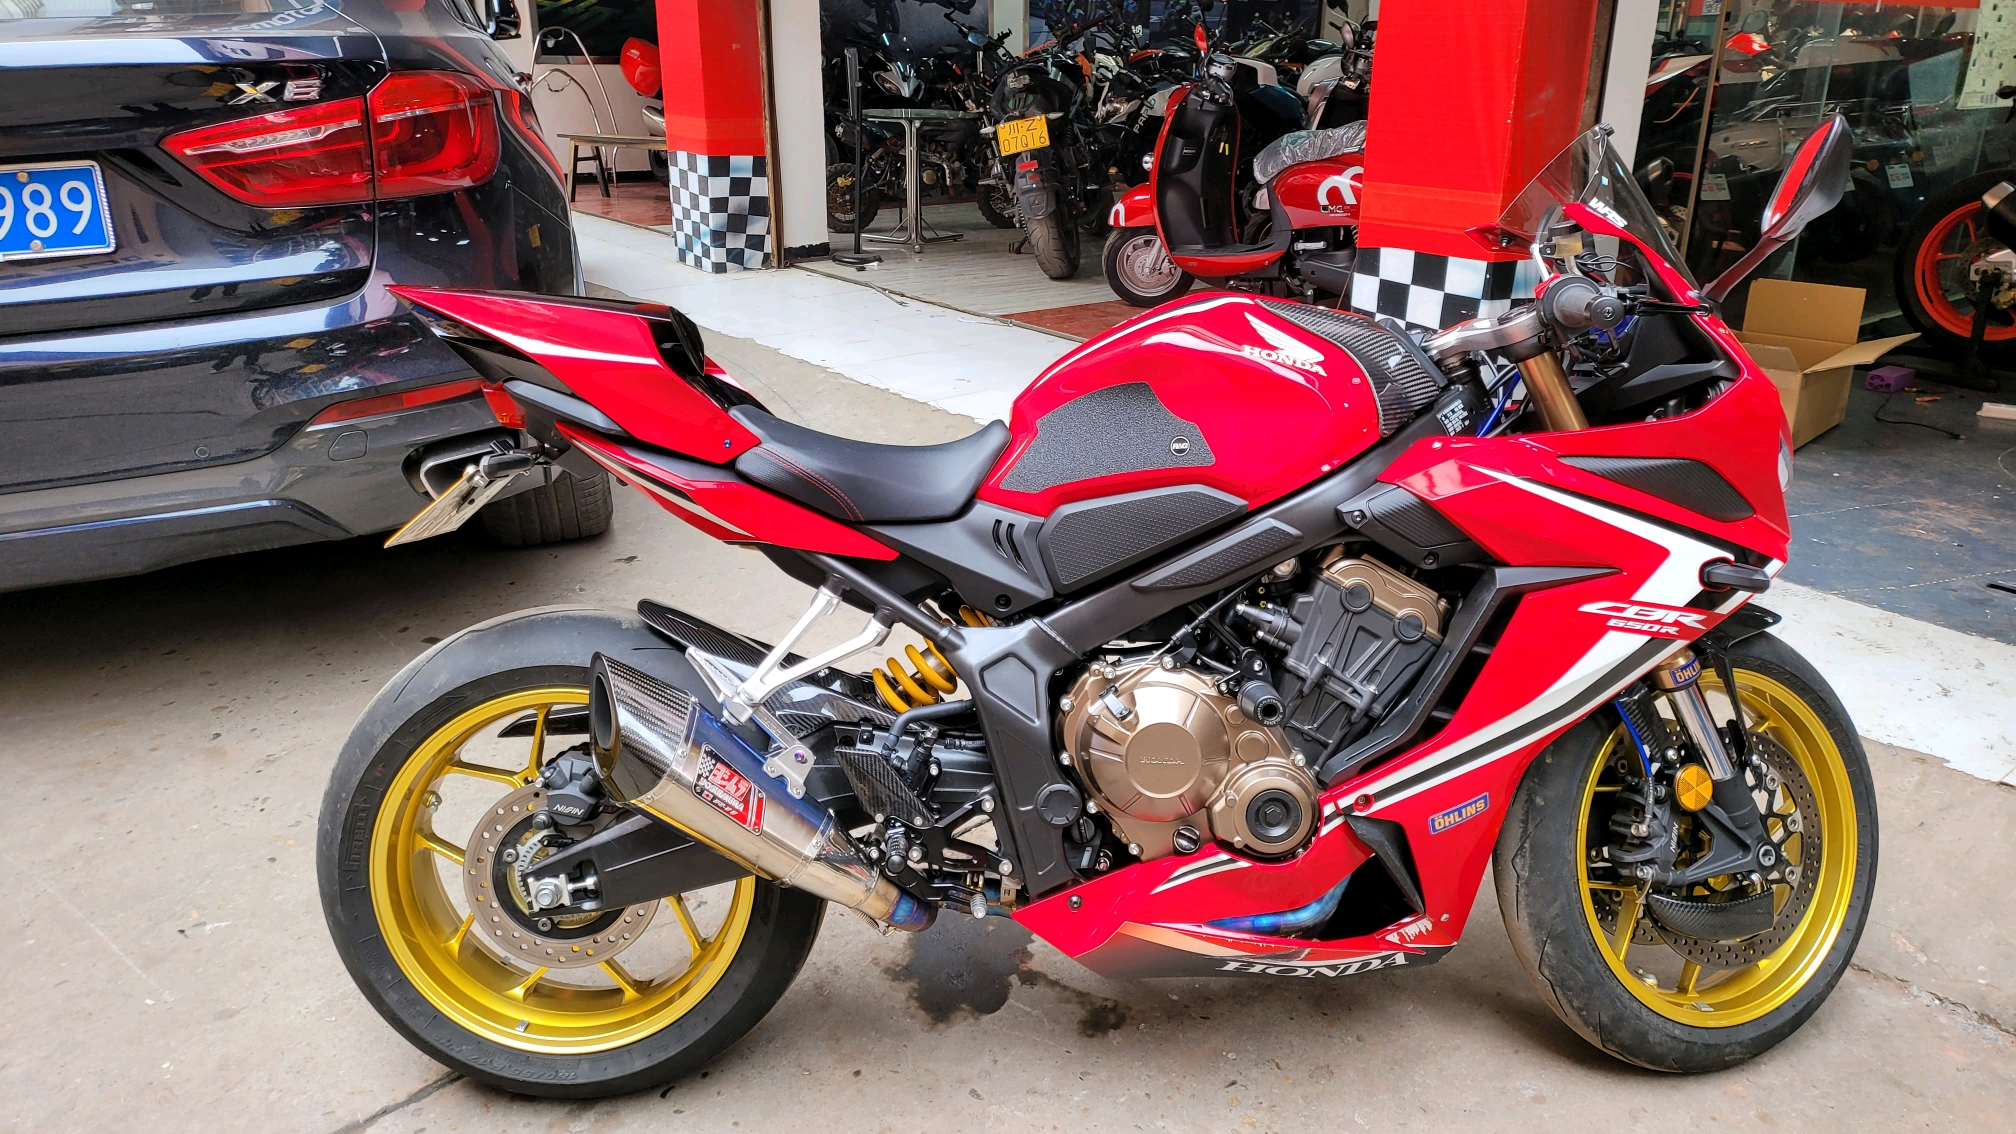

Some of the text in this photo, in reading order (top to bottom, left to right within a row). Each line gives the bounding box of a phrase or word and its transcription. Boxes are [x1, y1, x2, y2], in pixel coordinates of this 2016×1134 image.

[227, 80, 322, 105] X6
[1002, 130, 1047, 153] 07Q16
[1588, 197, 1628, 228] WRS
[1241, 344, 1328, 377] HONDA
[1577, 600, 1708, 630] CBR
[1606, 618, 1680, 636] 650R
[1675, 662, 1701, 683] ÖHLI
[1140, 756, 1186, 766] HONDA
[1434, 799, 1485, 831] ÖHLINS
[1215, 951, 1410, 979] HONDA
